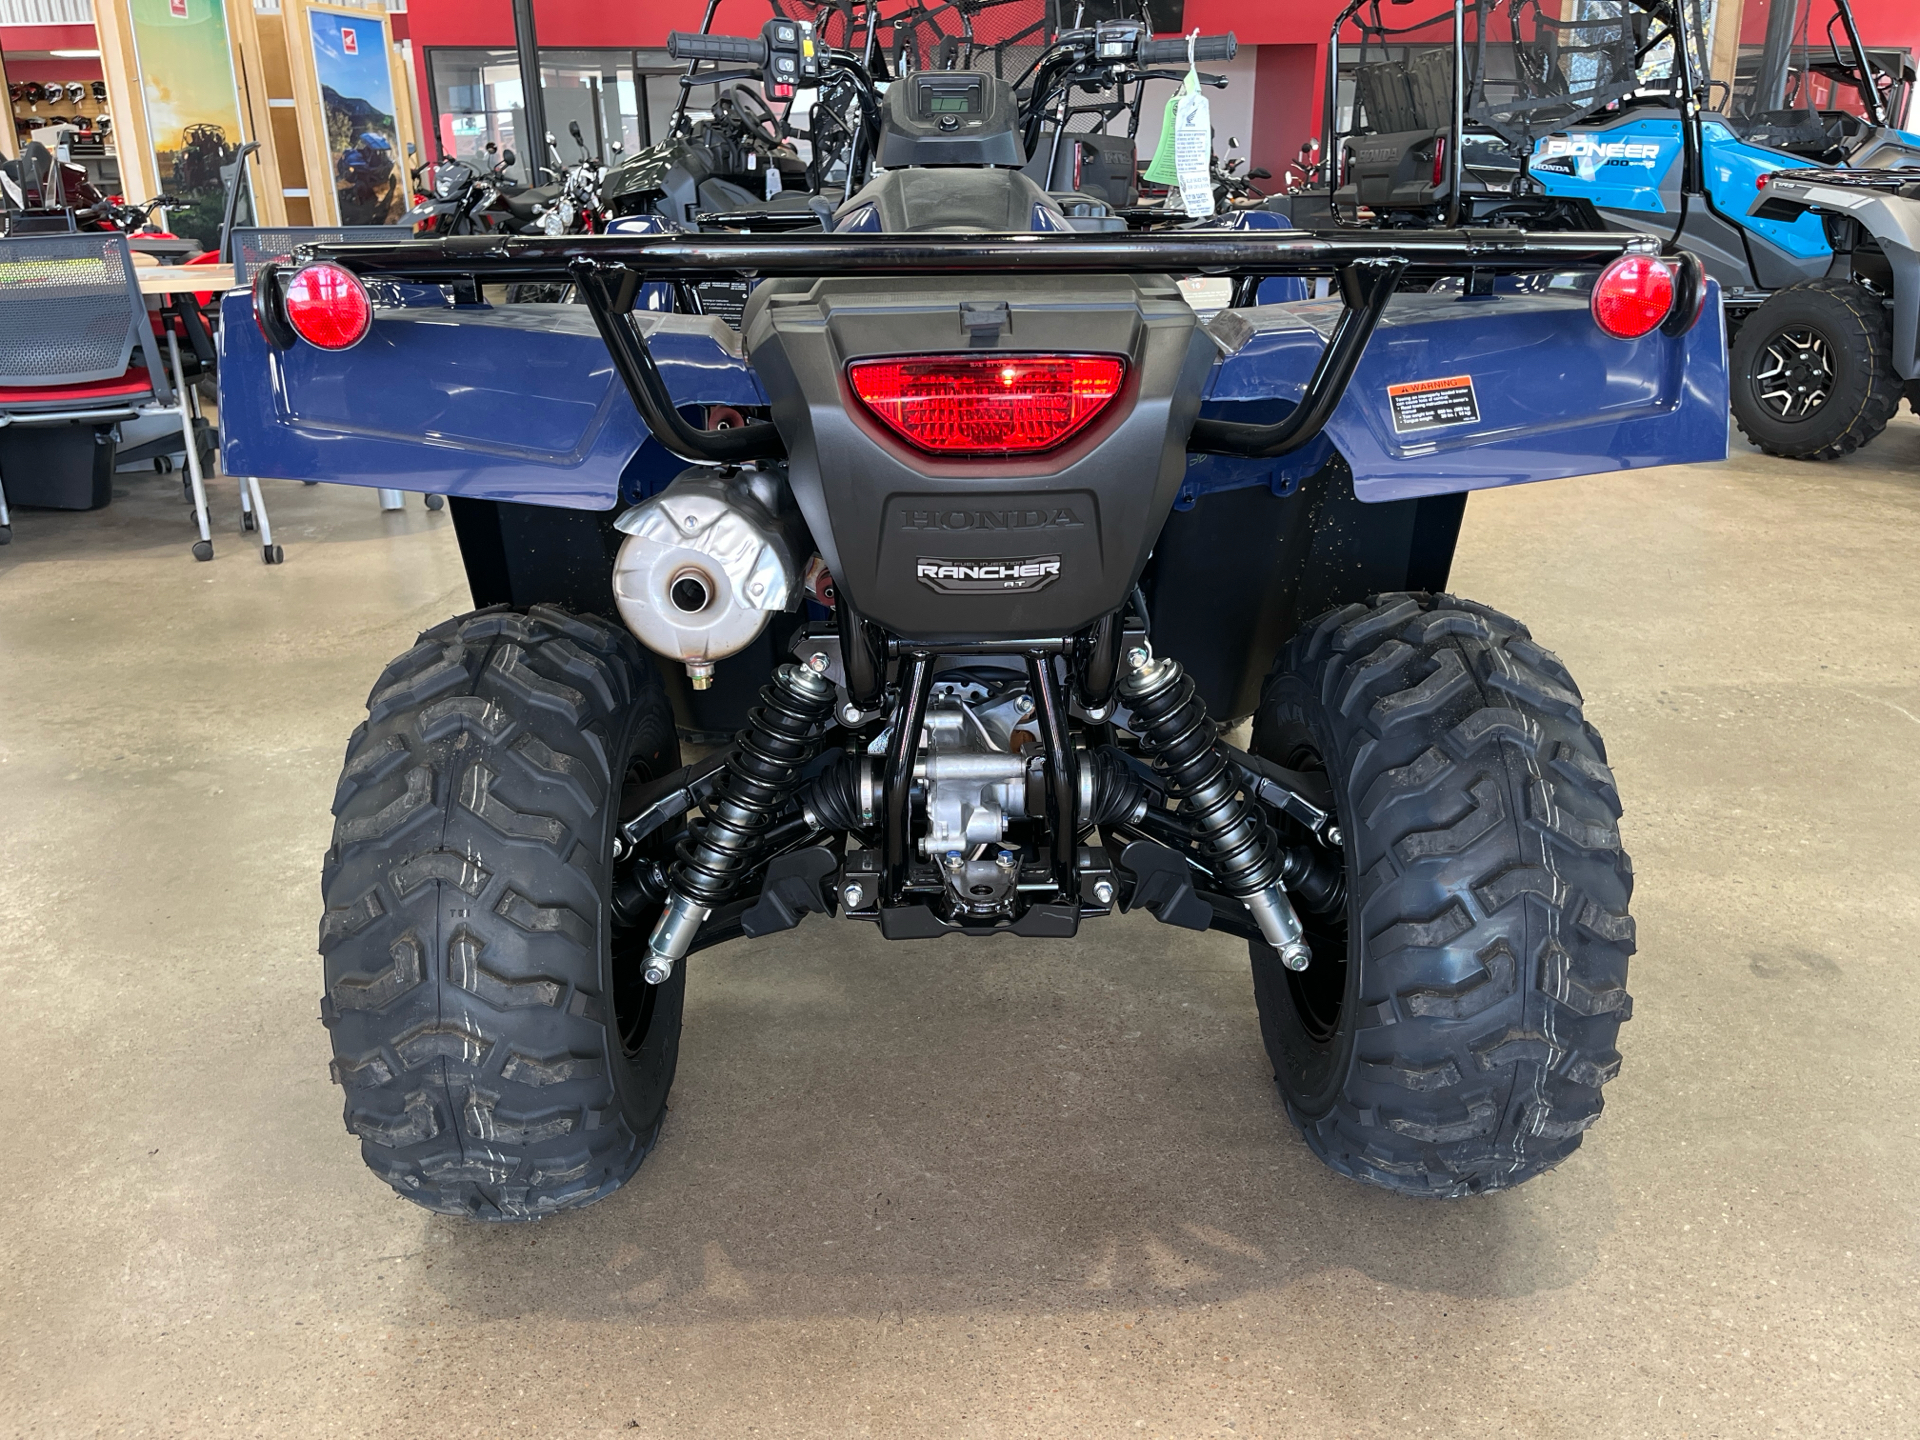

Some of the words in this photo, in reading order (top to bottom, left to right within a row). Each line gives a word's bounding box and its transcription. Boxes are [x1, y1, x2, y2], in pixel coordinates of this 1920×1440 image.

[1547, 141, 1660, 159] PIONEER
[1530, 163, 1571, 173] HONDA
[1411, 380, 1458, 392] WARNING
[901, 508, 1085, 531] HONDA
[917, 562, 1061, 579] RANCHER
